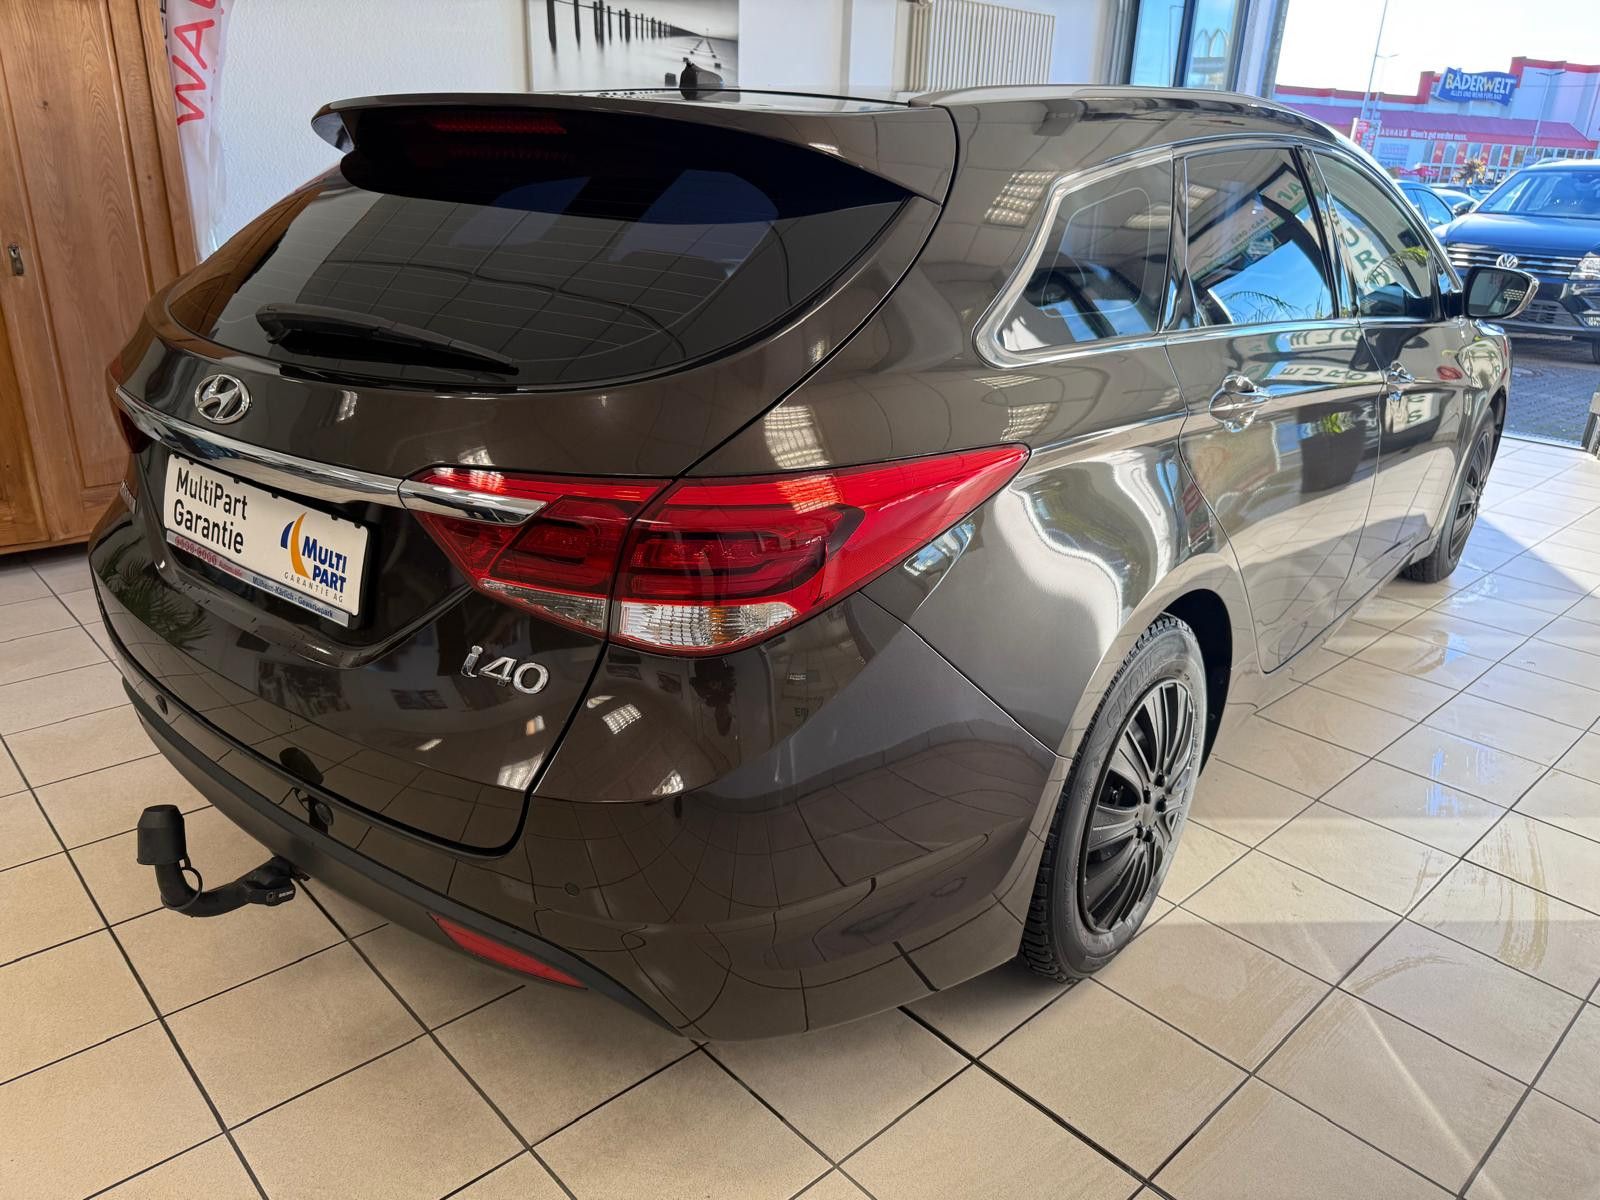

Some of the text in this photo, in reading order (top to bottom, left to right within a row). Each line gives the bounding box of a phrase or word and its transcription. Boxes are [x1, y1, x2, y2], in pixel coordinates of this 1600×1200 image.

[171, 0, 216, 126] WA
[1380, 127, 1408, 137] AUHAUS
[175, 467, 248, 521] MultiPart
[173, 498, 244, 554] Garantie
[301, 535, 348, 575] MULTI
[284, 571, 344, 603] GARANTIE AG
[312, 564, 347, 594] PART
[460, 645, 549, 694] i40
